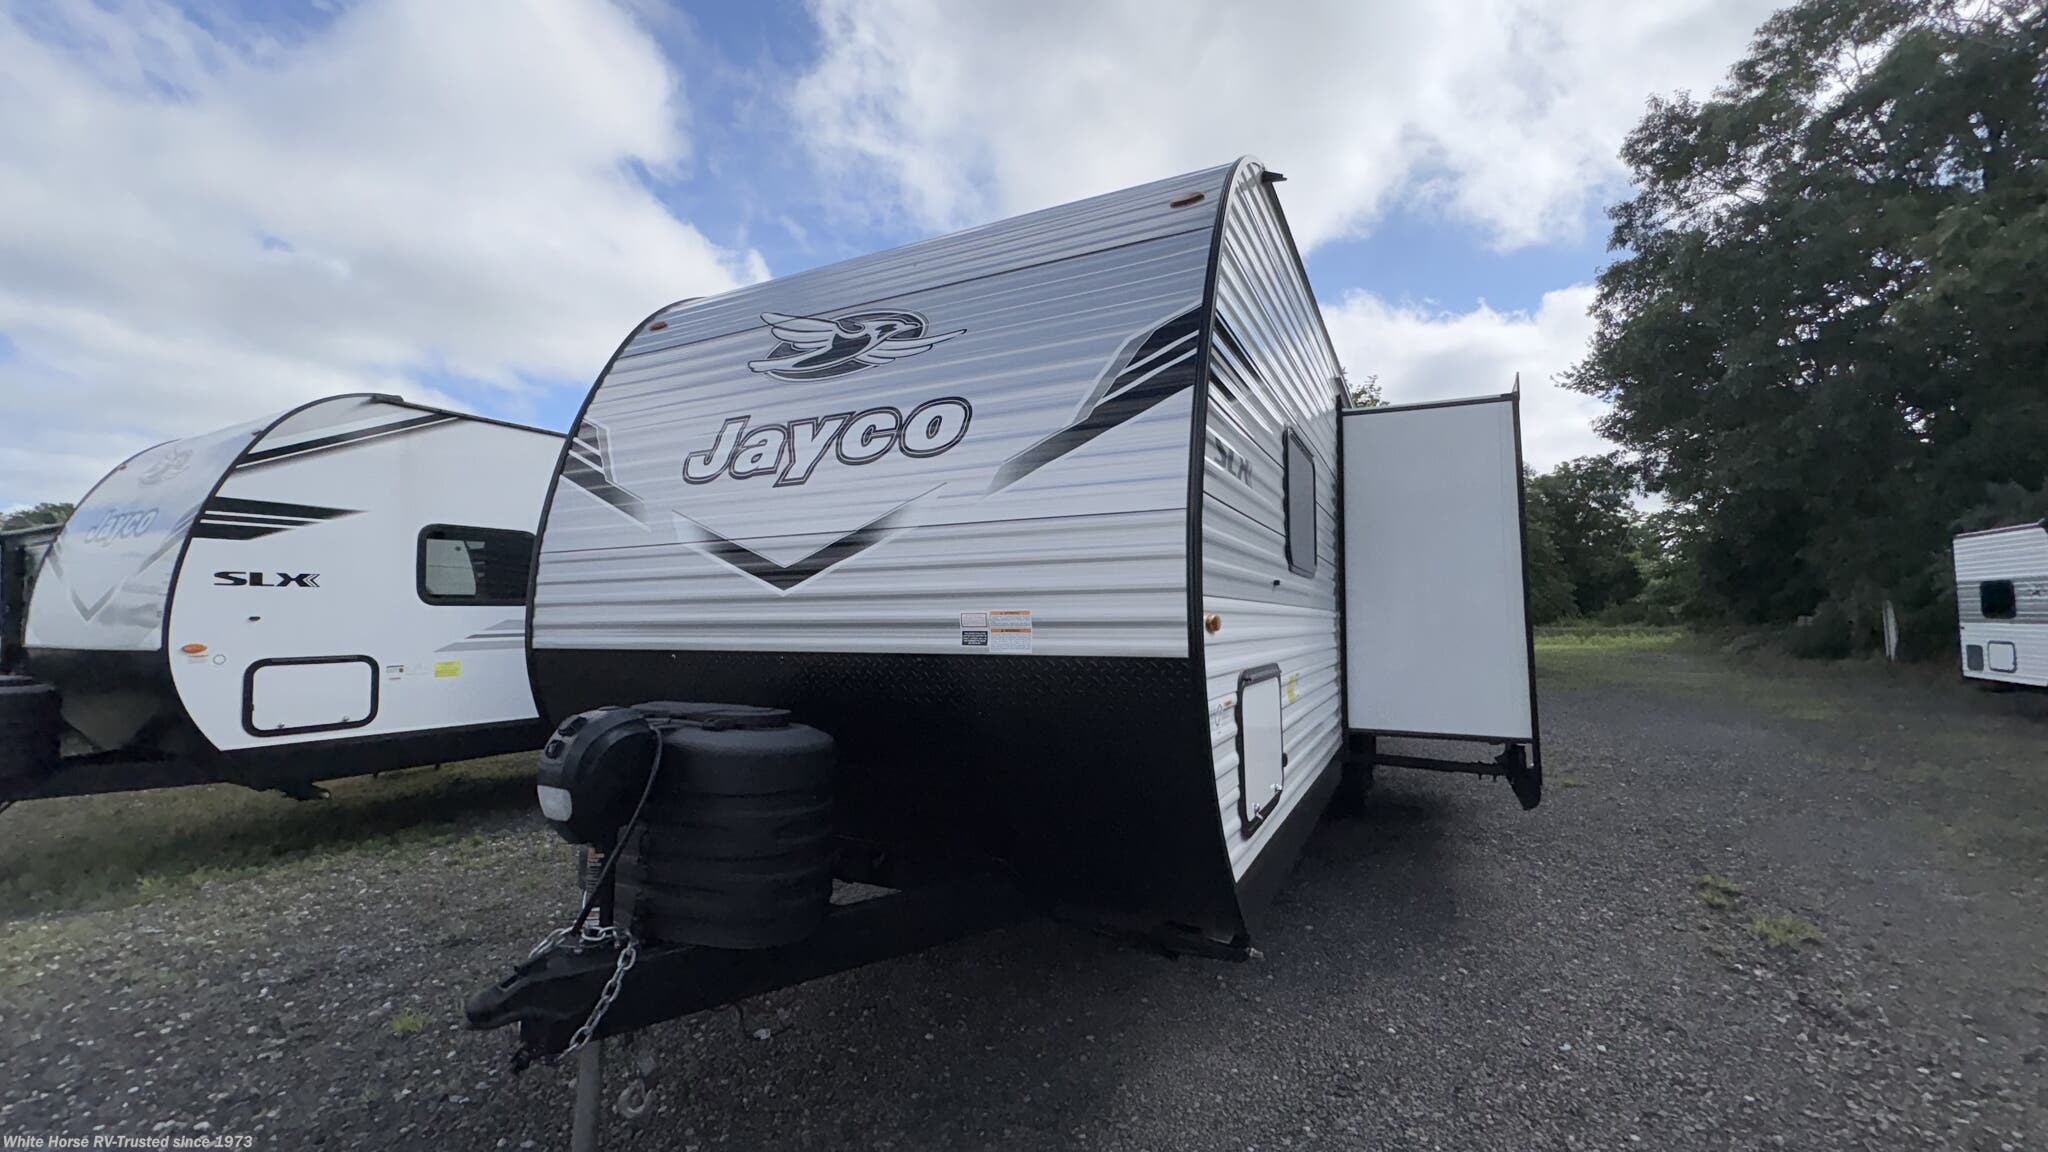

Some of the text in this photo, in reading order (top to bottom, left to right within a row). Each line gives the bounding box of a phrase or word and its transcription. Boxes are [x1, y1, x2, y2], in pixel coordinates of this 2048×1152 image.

[682, 396, 973, 488] Jayco
[84, 507, 159, 548] Jayco
[213, 571, 320, 588] SLX
